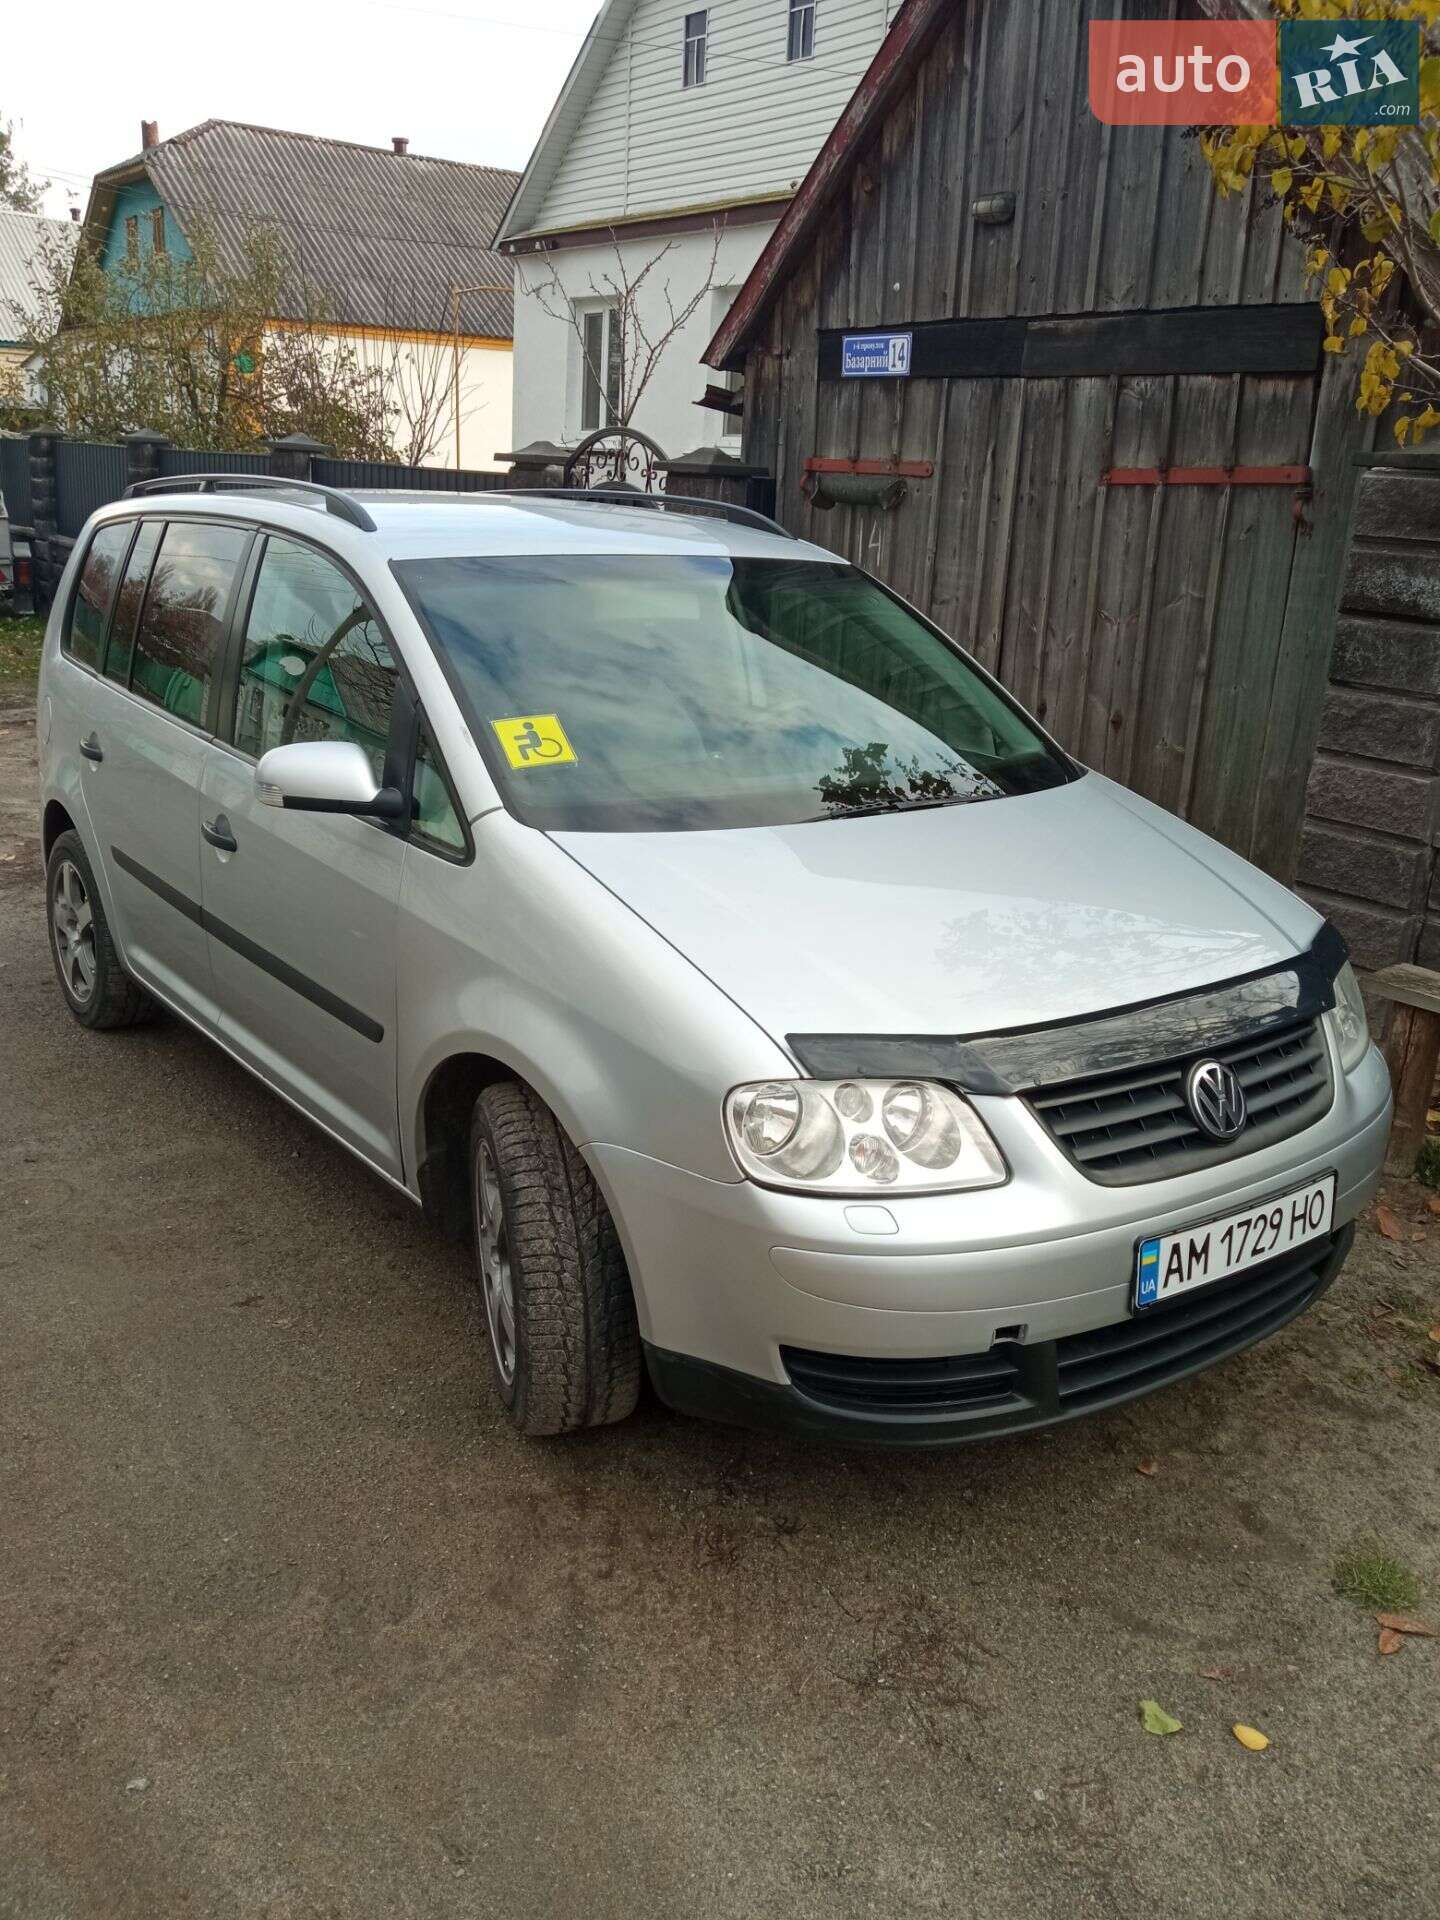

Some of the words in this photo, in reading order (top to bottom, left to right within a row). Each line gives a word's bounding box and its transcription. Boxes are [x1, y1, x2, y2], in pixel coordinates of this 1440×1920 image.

[846, 351, 889, 372] Базарний
[891, 342, 905, 369] 14
[1163, 1232, 1211, 1289] AM
[1220, 1207, 1284, 1267] 1729
[1289, 1190, 1325, 1241] HO
[1141, 1279, 1156, 1294] UA
